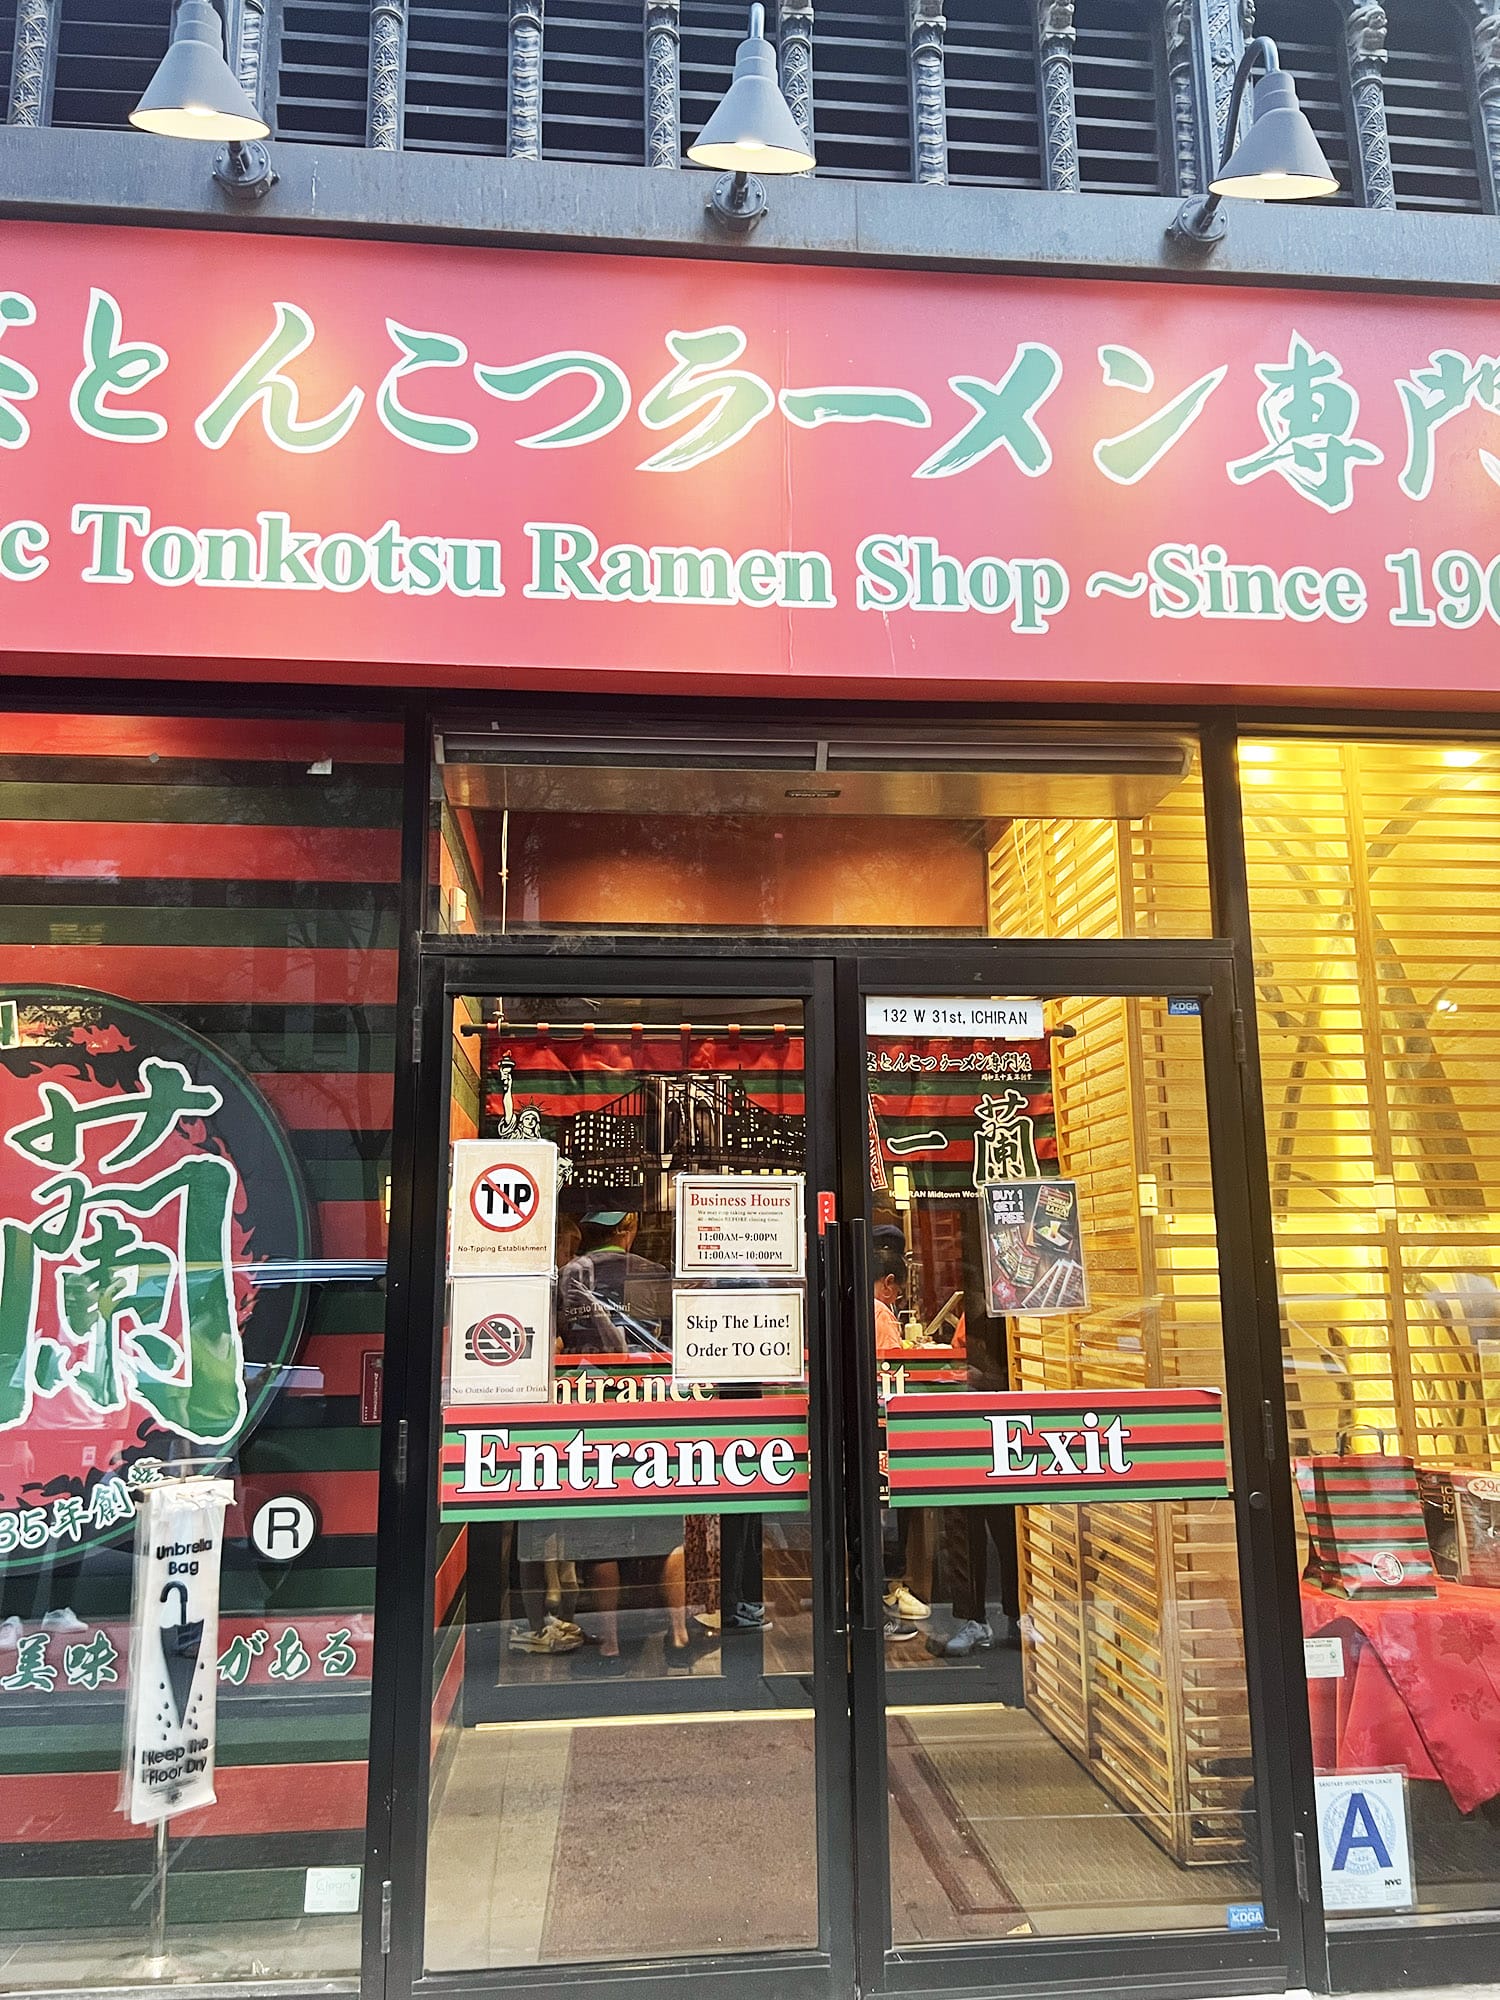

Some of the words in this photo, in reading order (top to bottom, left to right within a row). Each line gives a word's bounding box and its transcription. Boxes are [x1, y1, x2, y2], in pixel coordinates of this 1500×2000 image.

[72, 503, 504, 598] Tonkotsu
[523, 520, 836, 608] Ramen
[856, 534, 1069, 634] Shop
[883, 1008, 907, 1023] 132
[914, 1009, 925, 1023] W
[932, 1010, 966, 1025] 31st,
[971, 1010, 1028, 1025] ICHIRAN
[481, 1183, 532, 1215] TIP
[690, 1193, 747, 1207] Business
[751, 1193, 791, 1207] Hours
[927, 1190, 960, 1198] Midtown
[992, 1189, 1014, 1201] BUY
[1017, 1189, 1023, 1201] 1
[993, 1201, 1015, 1212] GET
[1018, 1201, 1024, 1211] 1
[994, 1212, 1025, 1225] FREE
[458, 1245, 496, 1253] No-Tipping
[686, 1315, 718, 1333] Skip
[722, 1315, 749, 1329] The
[753, 1314, 790, 1329] Line!
[686, 1343, 728, 1358] Order
[732, 1342, 755, 1357] TO
[759, 1341, 790, 1357] GO!
[465, 1386, 493, 1394] Outside
[526, 1384, 547, 1393] Drink
[552, 1370, 714, 1405] ntrance
[984, 1412, 1132, 1478] Exit
[455, 1429, 796, 1493] Entrance
[156, 1538, 213, 1560] Umbrella
[168, 1561, 199, 1576] Bag
[148, 1746, 185, 1767] Keep
[149, 1766, 183, 1785] Floor
[186, 1756, 207, 1773] Dry
[1331, 1792, 1394, 1871] A
[1384, 1878, 1402, 1887] NYC
